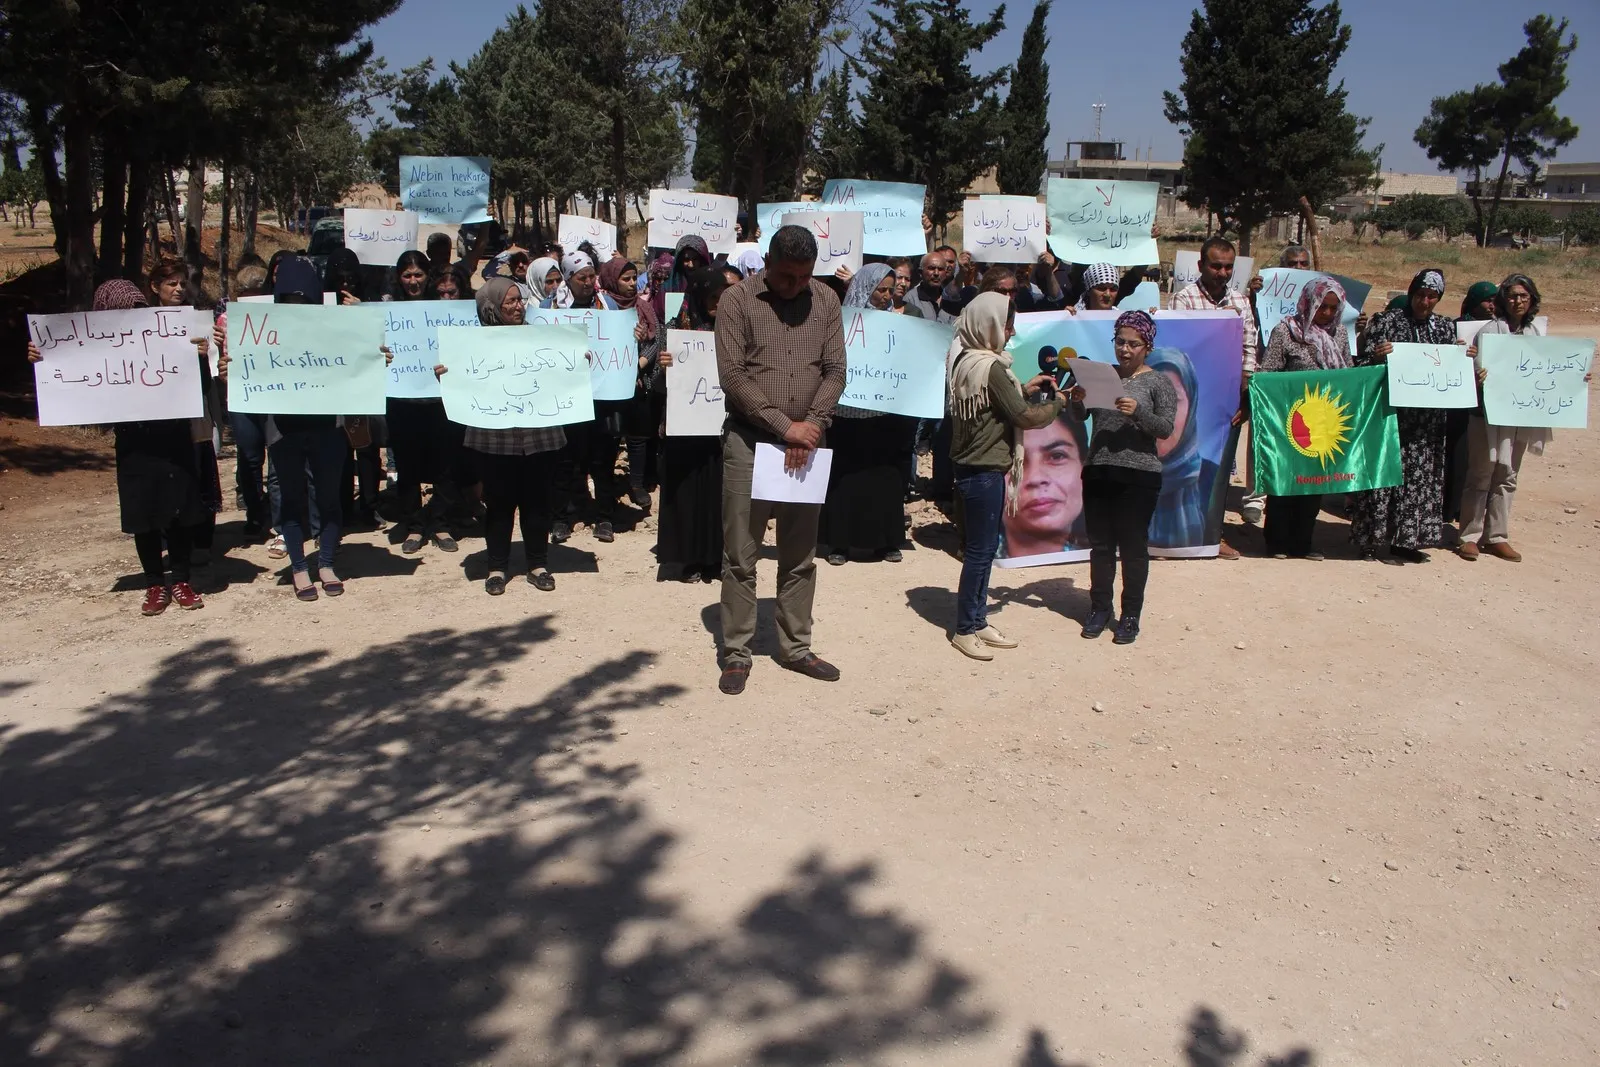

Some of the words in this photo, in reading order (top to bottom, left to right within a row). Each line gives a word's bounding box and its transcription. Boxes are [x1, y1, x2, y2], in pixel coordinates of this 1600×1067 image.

[410, 164, 443, 182] Nebin
[1095, 183, 1115, 206] لا
[701, 201, 717, 211] لا
[1068, 201, 1102, 225] التركي
[381, 214, 397, 227] لا
[814, 217, 830, 239] لا
[1262, 272, 1297, 299] Na
[385, 311, 415, 332] ebin
[1265, 302, 1273, 319] ji
[142, 310, 188, 356] قتلكم
[239, 313, 280, 346] Na
[884, 330, 896, 354] ji
[241, 354, 256, 380] ji
[512, 347, 557, 376] تكونوا
[559, 350, 577, 372] لا
[1423, 348, 1441, 366] لا
[1575, 356, 1588, 372] لا
[847, 364, 908, 388] girkeriya
[1535, 380, 1556, 394] في
[243, 383, 286, 402] jinan
[502, 378, 541, 401] في
[538, 395, 574, 416] قتل
[1548, 396, 1573, 415] قتل
